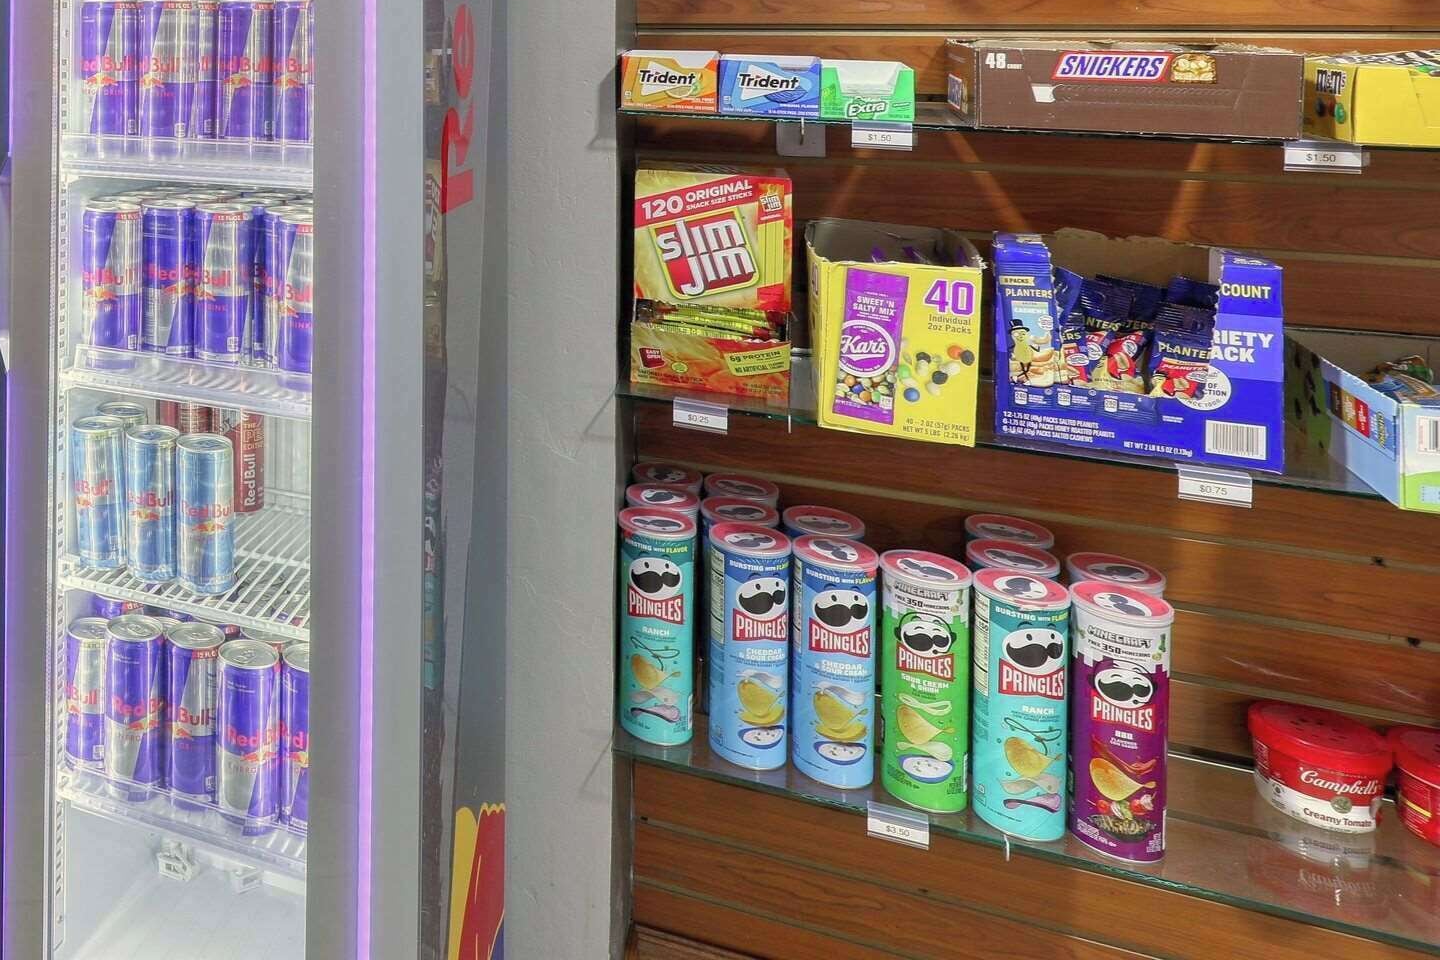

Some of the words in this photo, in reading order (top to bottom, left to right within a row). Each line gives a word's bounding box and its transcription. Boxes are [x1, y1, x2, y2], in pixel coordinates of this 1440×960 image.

[985, 53, 1006, 69] 48
[1062, 56, 1164, 78] SNICKERS
[640, 70, 695, 85] Trident
[739, 74, 799, 89] Trident
[848, 101, 887, 118] Extra
[868, 134, 891, 142] $1.50
[1306, 154, 1336, 163] $1.50
[685, 180, 753, 202] ORIGINAL
[642, 196, 684, 220] 120
[685, 201, 710, 211] SNACK
[710, 197, 727, 205] SIZE
[727, 191, 753, 202] STICKS
[923, 279, 975, 317] 40
[1005, 288, 1053, 299] PLANTERS
[1222, 283, 1271, 299] COUNT
[857, 296, 884, 306] SWEET
[853, 303, 876, 313] SALTY
[879, 307, 895, 316] MIX
[929, 314, 971, 325] Individual
[928, 323, 942, 331] 2oz
[945, 325, 971, 334] Packs
[743, 351, 781, 361] PROTEIN
[1210, 347, 1255, 364] ACK
[688, 414, 709, 424] $0.25
[244, 453, 256, 479] Bull
[244, 481, 256, 507] Red
[1200, 484, 1228, 496] $0.75
[730, 559, 764, 572] BURSTING
[806, 568, 840, 583] BURSTING
[629, 590, 681, 621] PRINGLES
[906, 598, 923, 608] 350
[995, 606, 1036, 621] BURSTING
[735, 613, 786, 639] PRINGLES
[812, 623, 869, 655] PRINGLES
[1102, 642, 1121, 654] 350
[899, 646, 951, 679] PRINGLES
[1003, 663, 1064, 697] PRINGLES
[112, 696, 145, 717] Red
[1022, 705, 1055, 715] RANCH
[1093, 696, 1153, 730] PRINGLES
[1300, 766, 1378, 795] Campbell's
[1303, 807, 1342, 826] Creamy
[886, 825, 910, 837] $3.50
